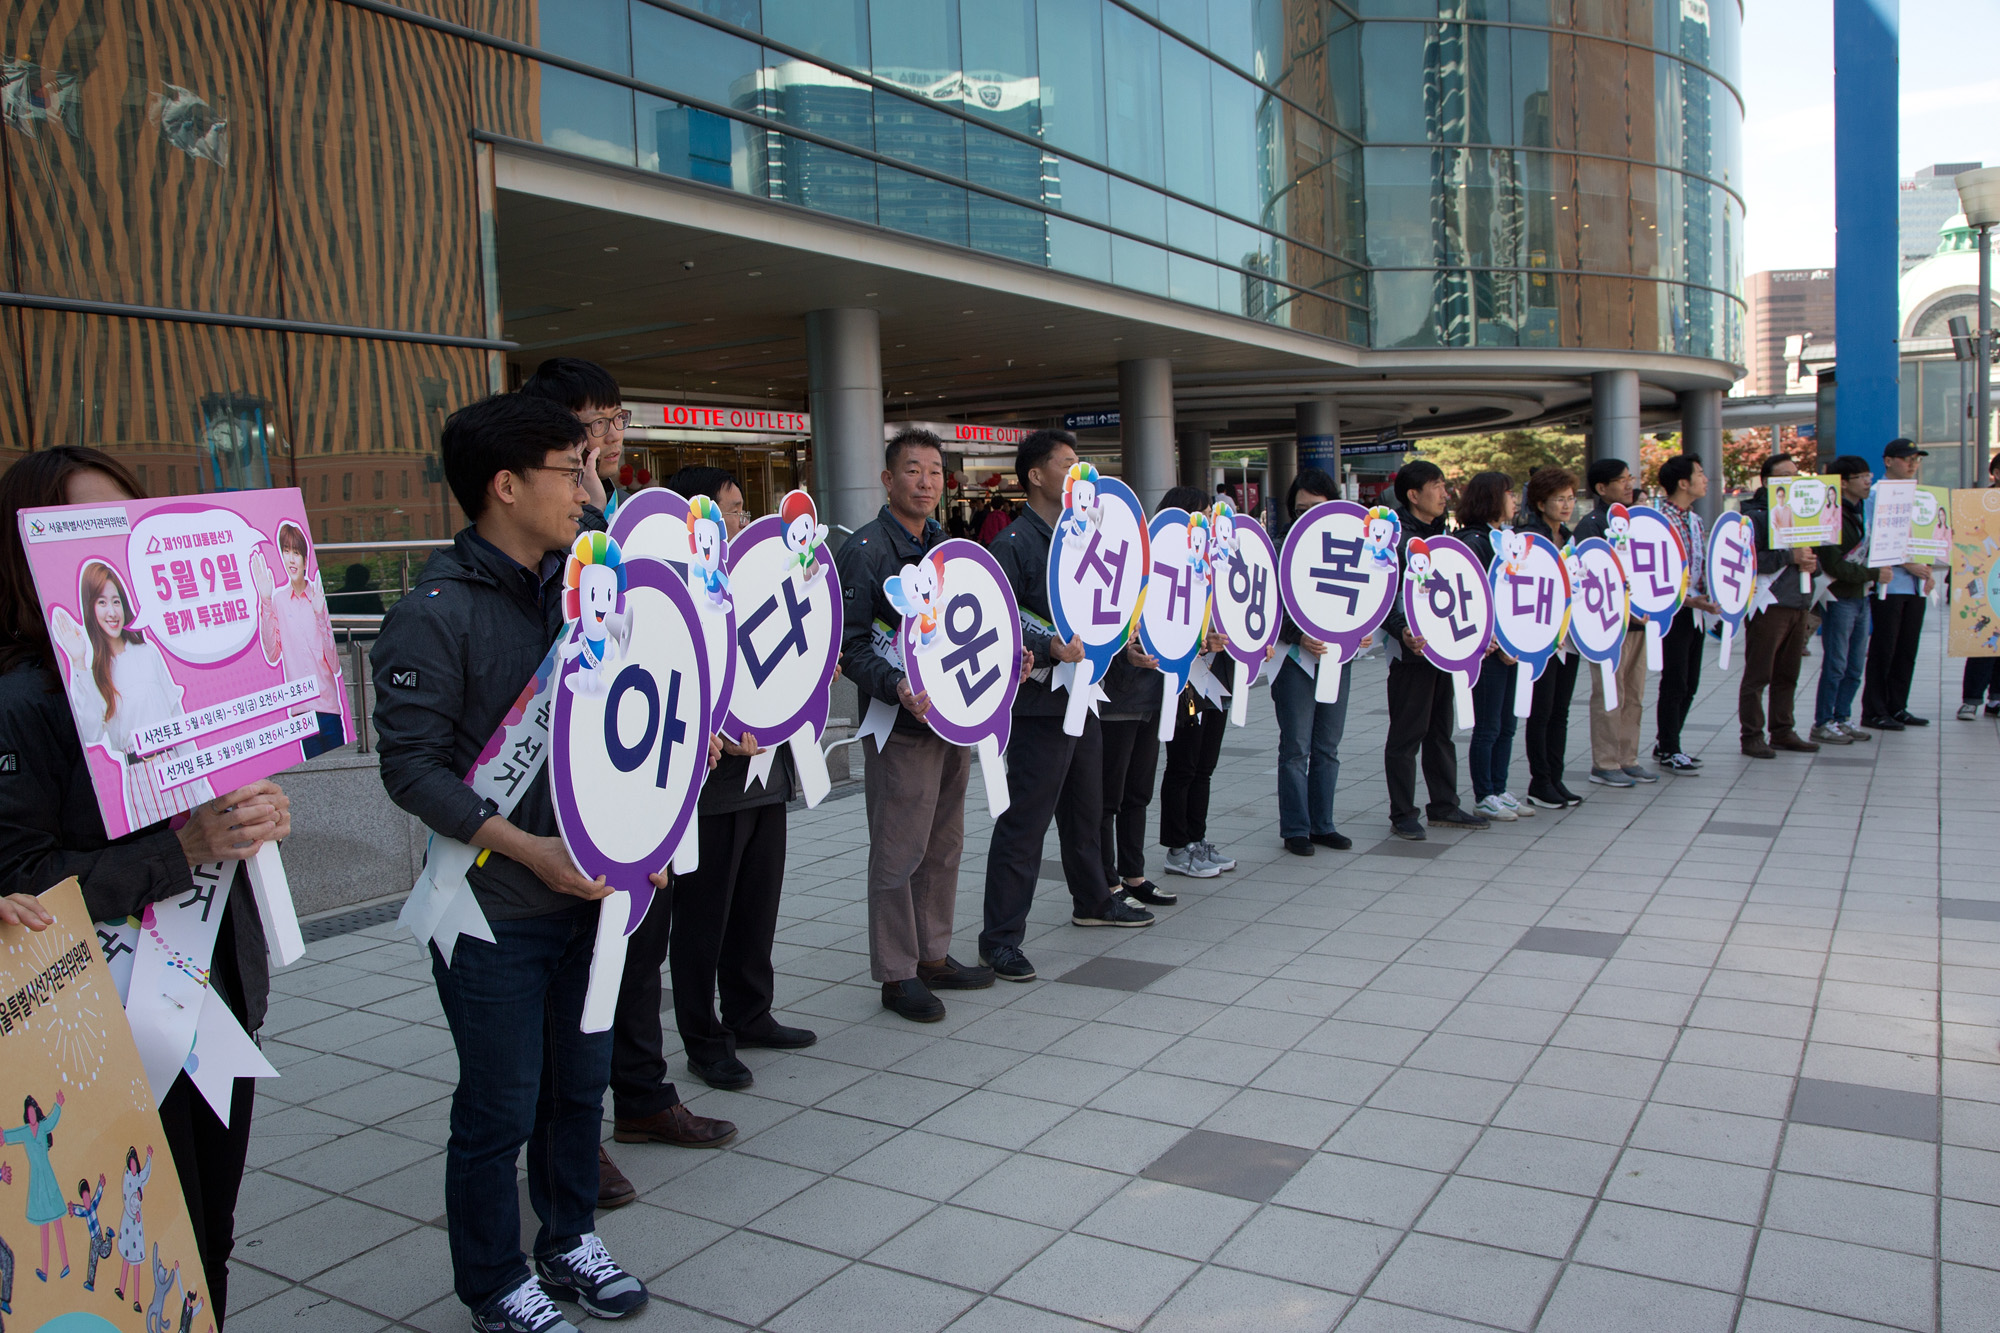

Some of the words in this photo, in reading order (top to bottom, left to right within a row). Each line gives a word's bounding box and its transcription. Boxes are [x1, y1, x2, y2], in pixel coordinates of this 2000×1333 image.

[663, 406, 725, 426] LOTTE
[730, 410, 805, 430] OUTLETS
[955, 425, 994, 441] LOTTE
[48, 516, 129, 533] 서울특별시선거관리위원회
[162, 534, 192, 551] 제19대
[192, 529, 234, 547] 대통령선거
[151, 560, 200, 601] 5월
[200, 553, 243, 593] 9일
[1074, 530, 1129, 625] 선
[1153, 561, 1192, 626] 거
[1228, 549, 1267, 640] 행
[1309, 531, 1370, 616] 복
[1509, 574, 1554, 625] 대
[1630, 538, 1675, 598] 민
[1720, 537, 1745, 603] 국
[163, 609, 196, 636] 함께
[196, 598, 250, 628] 투표해요
[1424, 568, 1477, 642] 한
[1581, 568, 1621, 632] 한
[737, 577, 812, 690] 다
[940, 592, 1002, 708] 운
[144, 722, 183, 744] 사전투표
[604, 663, 687, 789] 아
[166, 758, 195, 781] 선거일
[195, 752, 214, 769] 투표
[494, 736, 543, 798] 선거
[0, 939, 95, 1037] 울특별시선거관리위원회
